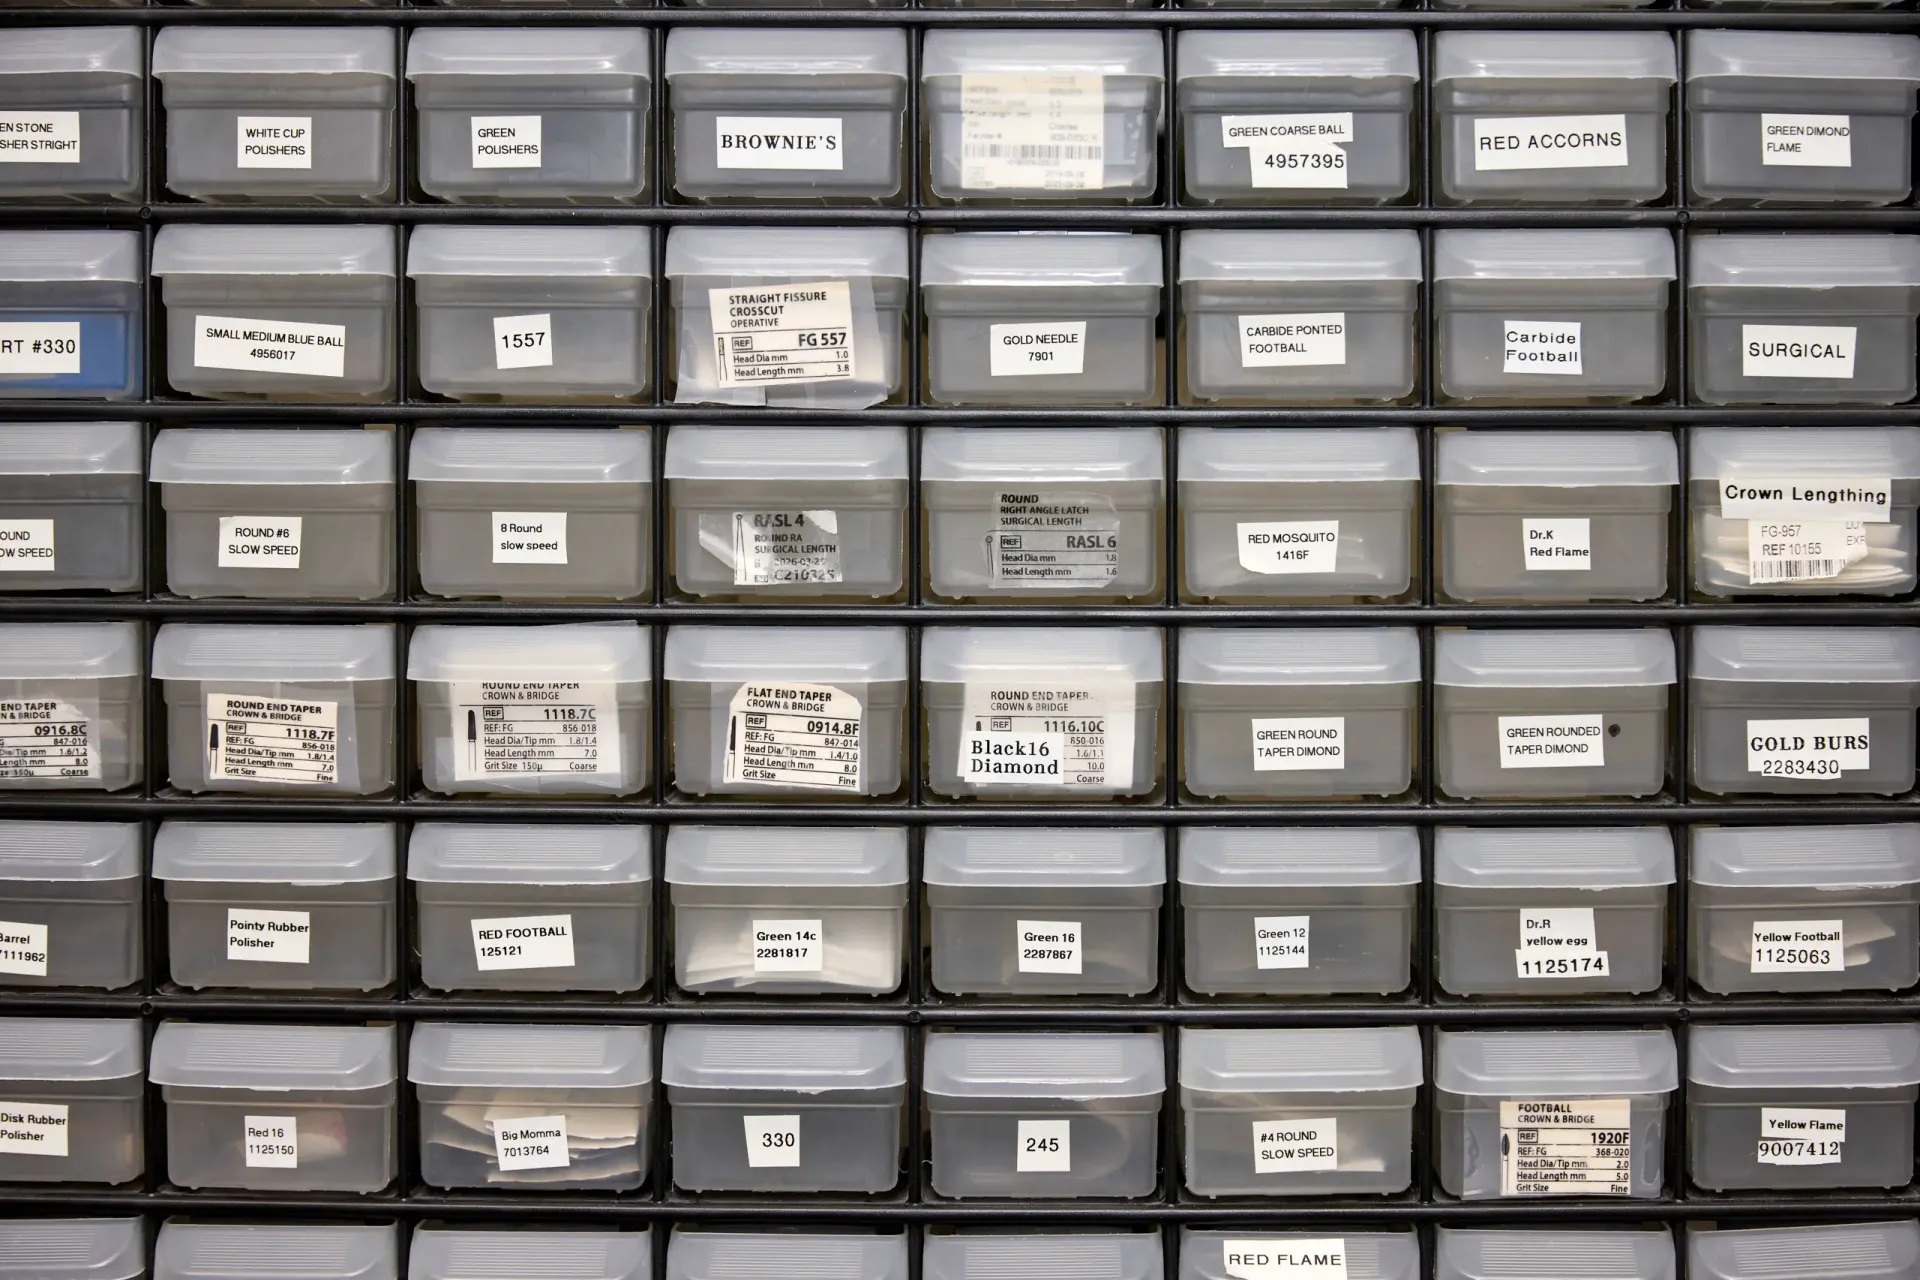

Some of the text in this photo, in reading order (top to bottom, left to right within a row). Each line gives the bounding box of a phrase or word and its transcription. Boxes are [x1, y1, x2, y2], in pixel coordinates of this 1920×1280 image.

[16, 123, 53, 132] STONE
[478, 128, 515, 137] GREEN
[1229, 125, 1344, 137] GREEN COARSE BALL
[1767, 126, 1849, 137] GREEN DIMOND
[246, 129, 307, 138] WHITE CUP
[31, 140, 77, 151] STRIGHT
[722, 135, 837, 150] BROWNIE'S
[1481, 132, 1621, 150] RED ACCORNS
[246, 145, 307, 155] POLISHERS
[478, 145, 538, 154] POLISHERS
[1767, 143, 1801, 152] FLAME
[1265, 154, 1344, 168] 4957395
[729, 292, 826, 304] STRAIGHT FISSURE
[730, 305, 784, 317] CROSSCUT
[731, 317, 780, 328] OPERATIVE
[1247, 325, 1342, 336] CARBIDE PONTED
[207, 328, 344, 348] SMALL MEDIUM BLUE BALL
[502, 332, 545, 348] 1557
[799, 332, 847, 347] FG 557
[1004, 334, 1078, 345] GOLD NEEDLE
[1507, 331, 1575, 344] Carbide
[2, 339, 75, 353] RT #330
[1250, 343, 1306, 353] FOOTBALL
[1749, 342, 1845, 358] SURGICAL
[250, 349, 295, 360] 4956017
[1029, 352, 1053, 361] 7901
[1507, 350, 1577, 362] Football
[1001, 494, 1038, 503] ROUND
[1726, 485, 1886, 505] Crown Lengthing
[1001, 506, 1089, 514] RIGHT ANGLE LATCH
[1001, 517, 1081, 527] SURGICAL LENGTH
[236, 528, 289, 539] ROUND #6
[501, 524, 542, 532] 8 Round
[1762, 525, 1801, 539] FG-957
[0, 531, 30, 540] OUND
[1249, 533, 1335, 545] RED MOSQUITO
[1530, 530, 1553, 539] Dr.K
[501, 541, 557, 552] slow speed
[1067, 535, 1116, 549] RASL 6
[18, 547, 53, 558] SPEED
[229, 545, 298, 555] SLOW SPEED
[1277, 550, 1309, 560] 1416F
[1530, 547, 1589, 557] Red Flame
[1763, 543, 1821, 557] REF 10155
[748, 688, 831, 702] FLAT END TAPER
[227, 701, 321, 714] ROUND END TAPER
[226, 710, 302, 723] CROWN & BRIDGE
[543, 709, 597, 720] 1118.7C
[34, 726, 87, 737] 0916.8C
[807, 721, 859, 735] 0914.8F
[1045, 721, 1104, 734] 1116.10C
[1507, 726, 1601, 739] GREEN ROUNDED
[286, 728, 334, 741] 1118.7F
[1257, 729, 1337, 740] GREEN ROUND
[970, 740, 1049, 756] Black16
[1751, 735, 1869, 751] GOLD BURS
[1258, 746, 1340, 757] TAPER DIMOND
[1508, 744, 1588, 754] TAPER DIMOND
[569, 762, 597, 772] Coarse
[970, 759, 1058, 774] Diamond
[1763, 760, 1839, 775] 2283430
[838, 776, 856, 787] Fine
[231, 920, 309, 934] Pointy Rubber
[1527, 919, 1550, 930] Dr.R
[479, 927, 567, 939] RED FOOTBALL
[757, 932, 816, 942] Green 14c
[1025, 932, 1074, 944] Green 16
[1258, 928, 1305, 940] Green 12
[1755, 932, 1839, 943] Yellow Football
[230, 937, 274, 949] Polisher
[1527, 937, 1587, 948] yellow egg
[481, 946, 523, 956] 125121
[757, 948, 807, 959] 2281817
[1024, 949, 1072, 959] 2287867
[1258, 946, 1304, 955] 1125144
[1756, 949, 1830, 964] 1125063
[1523, 958, 1604, 975] 1125174
[1519, 1104, 1571, 1114] FOOTBALL
[1, 1113, 66, 1125] Disk Rubber
[1518, 1115, 1594, 1123] CROWN & BRIDGE
[1770, 1120, 1843, 1132] Yellow Flame
[1, 1130, 44, 1140] Polisher
[249, 1128, 283, 1137] Red 16
[502, 1130, 561, 1144] Big Momma
[1261, 1131, 1317, 1144] #4 ROUND
[763, 1133, 794, 1147] 330
[1591, 1132, 1630, 1145] 1920F
[248, 1145, 294, 1156] 1125150
[1027, 1138, 1060, 1152] 245
[1758, 1140, 1839, 1157] 9007412
[504, 1146, 549, 1159] 7013764
[1262, 1147, 1334, 1161] SLOW SPEED
[1610, 1184, 1628, 1193] Fine
[1230, 1254, 1341, 1265] RED FLAME
